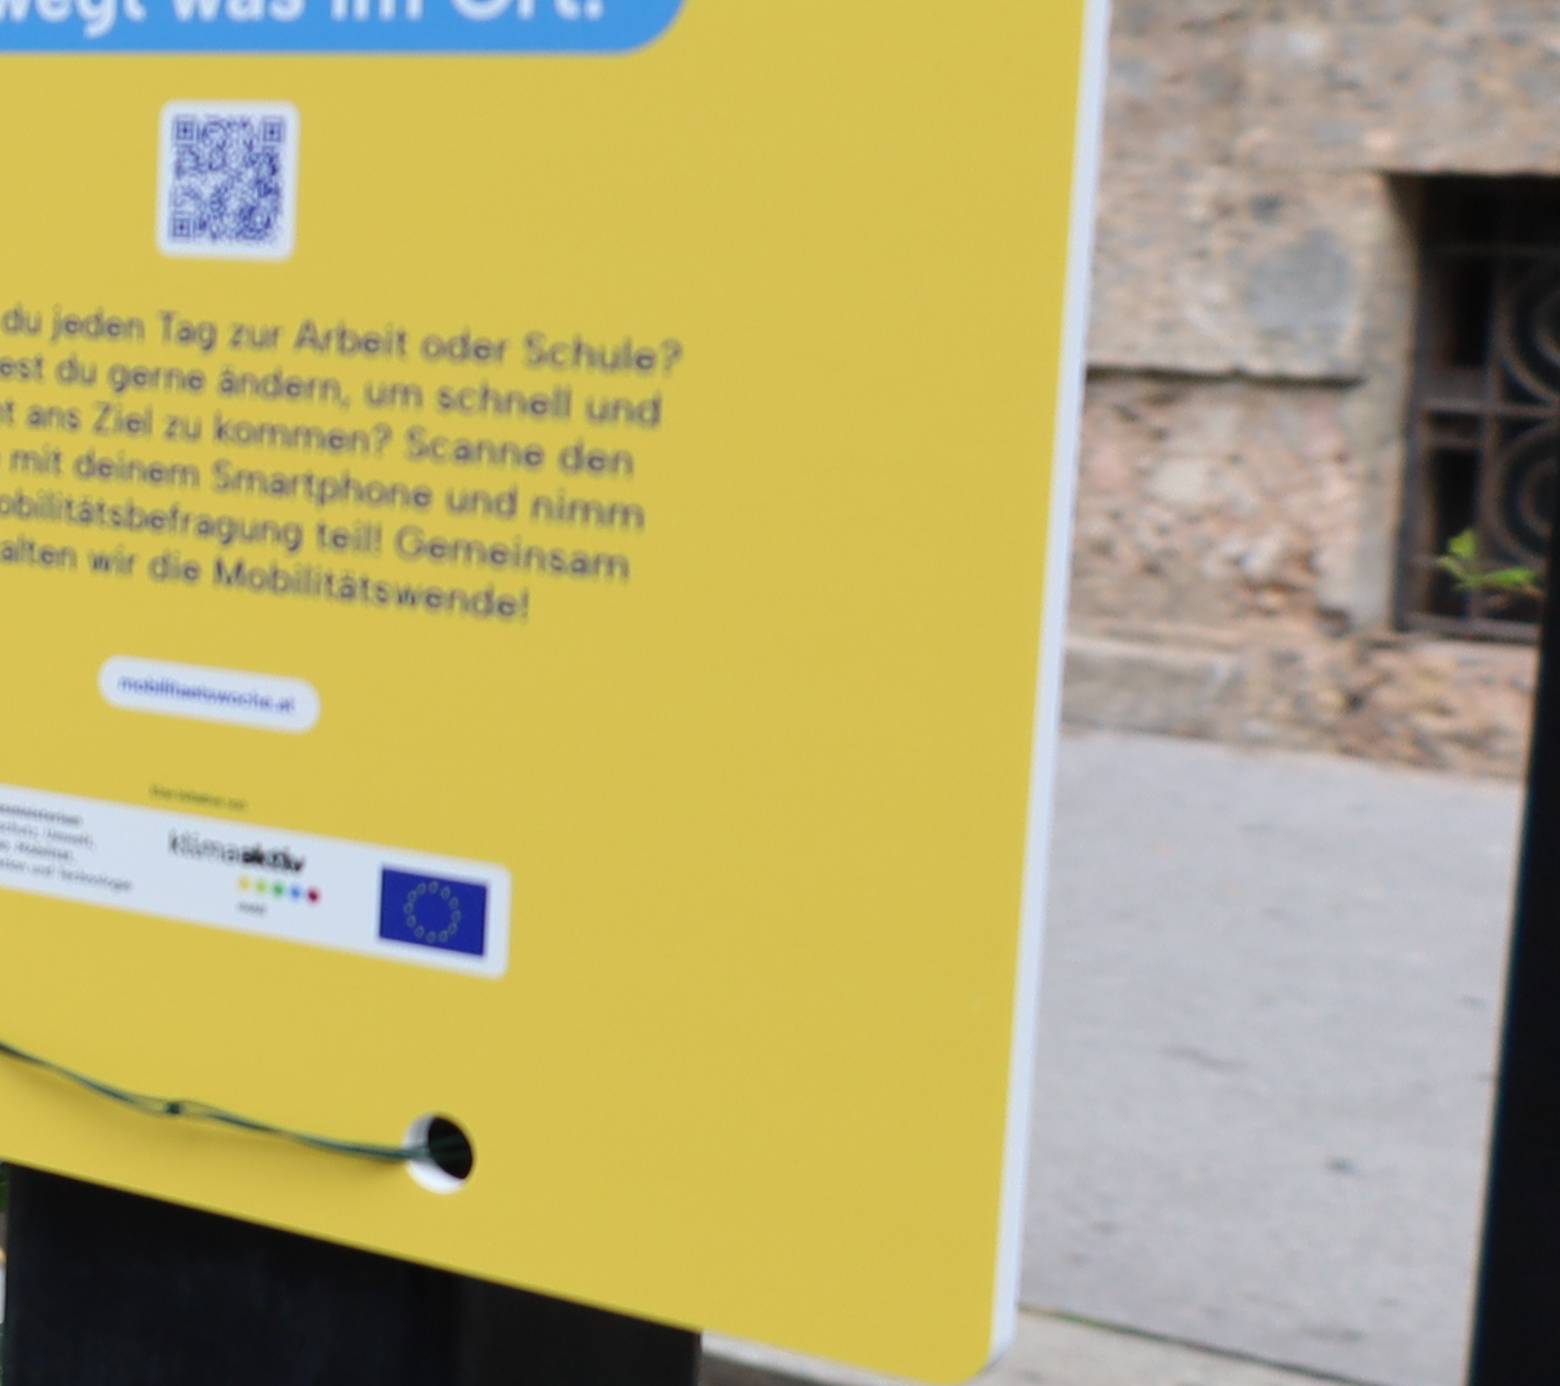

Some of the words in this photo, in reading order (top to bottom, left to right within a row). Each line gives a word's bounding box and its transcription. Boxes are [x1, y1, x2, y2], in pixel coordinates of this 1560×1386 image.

[0, 302, 42, 336] du
[50, 305, 145, 343] jeden
[159, 310, 217, 353] Tag
[229, 321, 280, 351] zur
[294, 318, 407, 359] Arbeit
[423, 327, 508, 364] oder
[523, 330, 683, 377] Schule?
[55, 353, 96, 387] du
[107, 361, 205, 395] gerne
[217, 363, 351, 409] ändern,
[363, 381, 423, 409] um
[437, 379, 571, 421] schnell
[585, 390, 661, 429] und
[26, 401, 81, 433] ans
[91, 401, 153, 439] Ziel
[163, 414, 202, 443] zu
[214, 409, 393, 455] kommen?
[404, 423, 545, 469] Scanne
[558, 438, 635, 479] den
[9, 444, 62, 478] mit
[73, 449, 200, 489] deinem
[211, 458, 433, 510] Smartphone
[446, 482, 518, 521] und
[529, 489, 646, 531] nimm
[88, 543, 139, 578] wir
[148, 549, 201, 584] die
[212, 555, 529, 622] Mobilitätswende!
[316, 519, 382, 554] teil!
[393, 524, 630, 582] Gemeinsam
